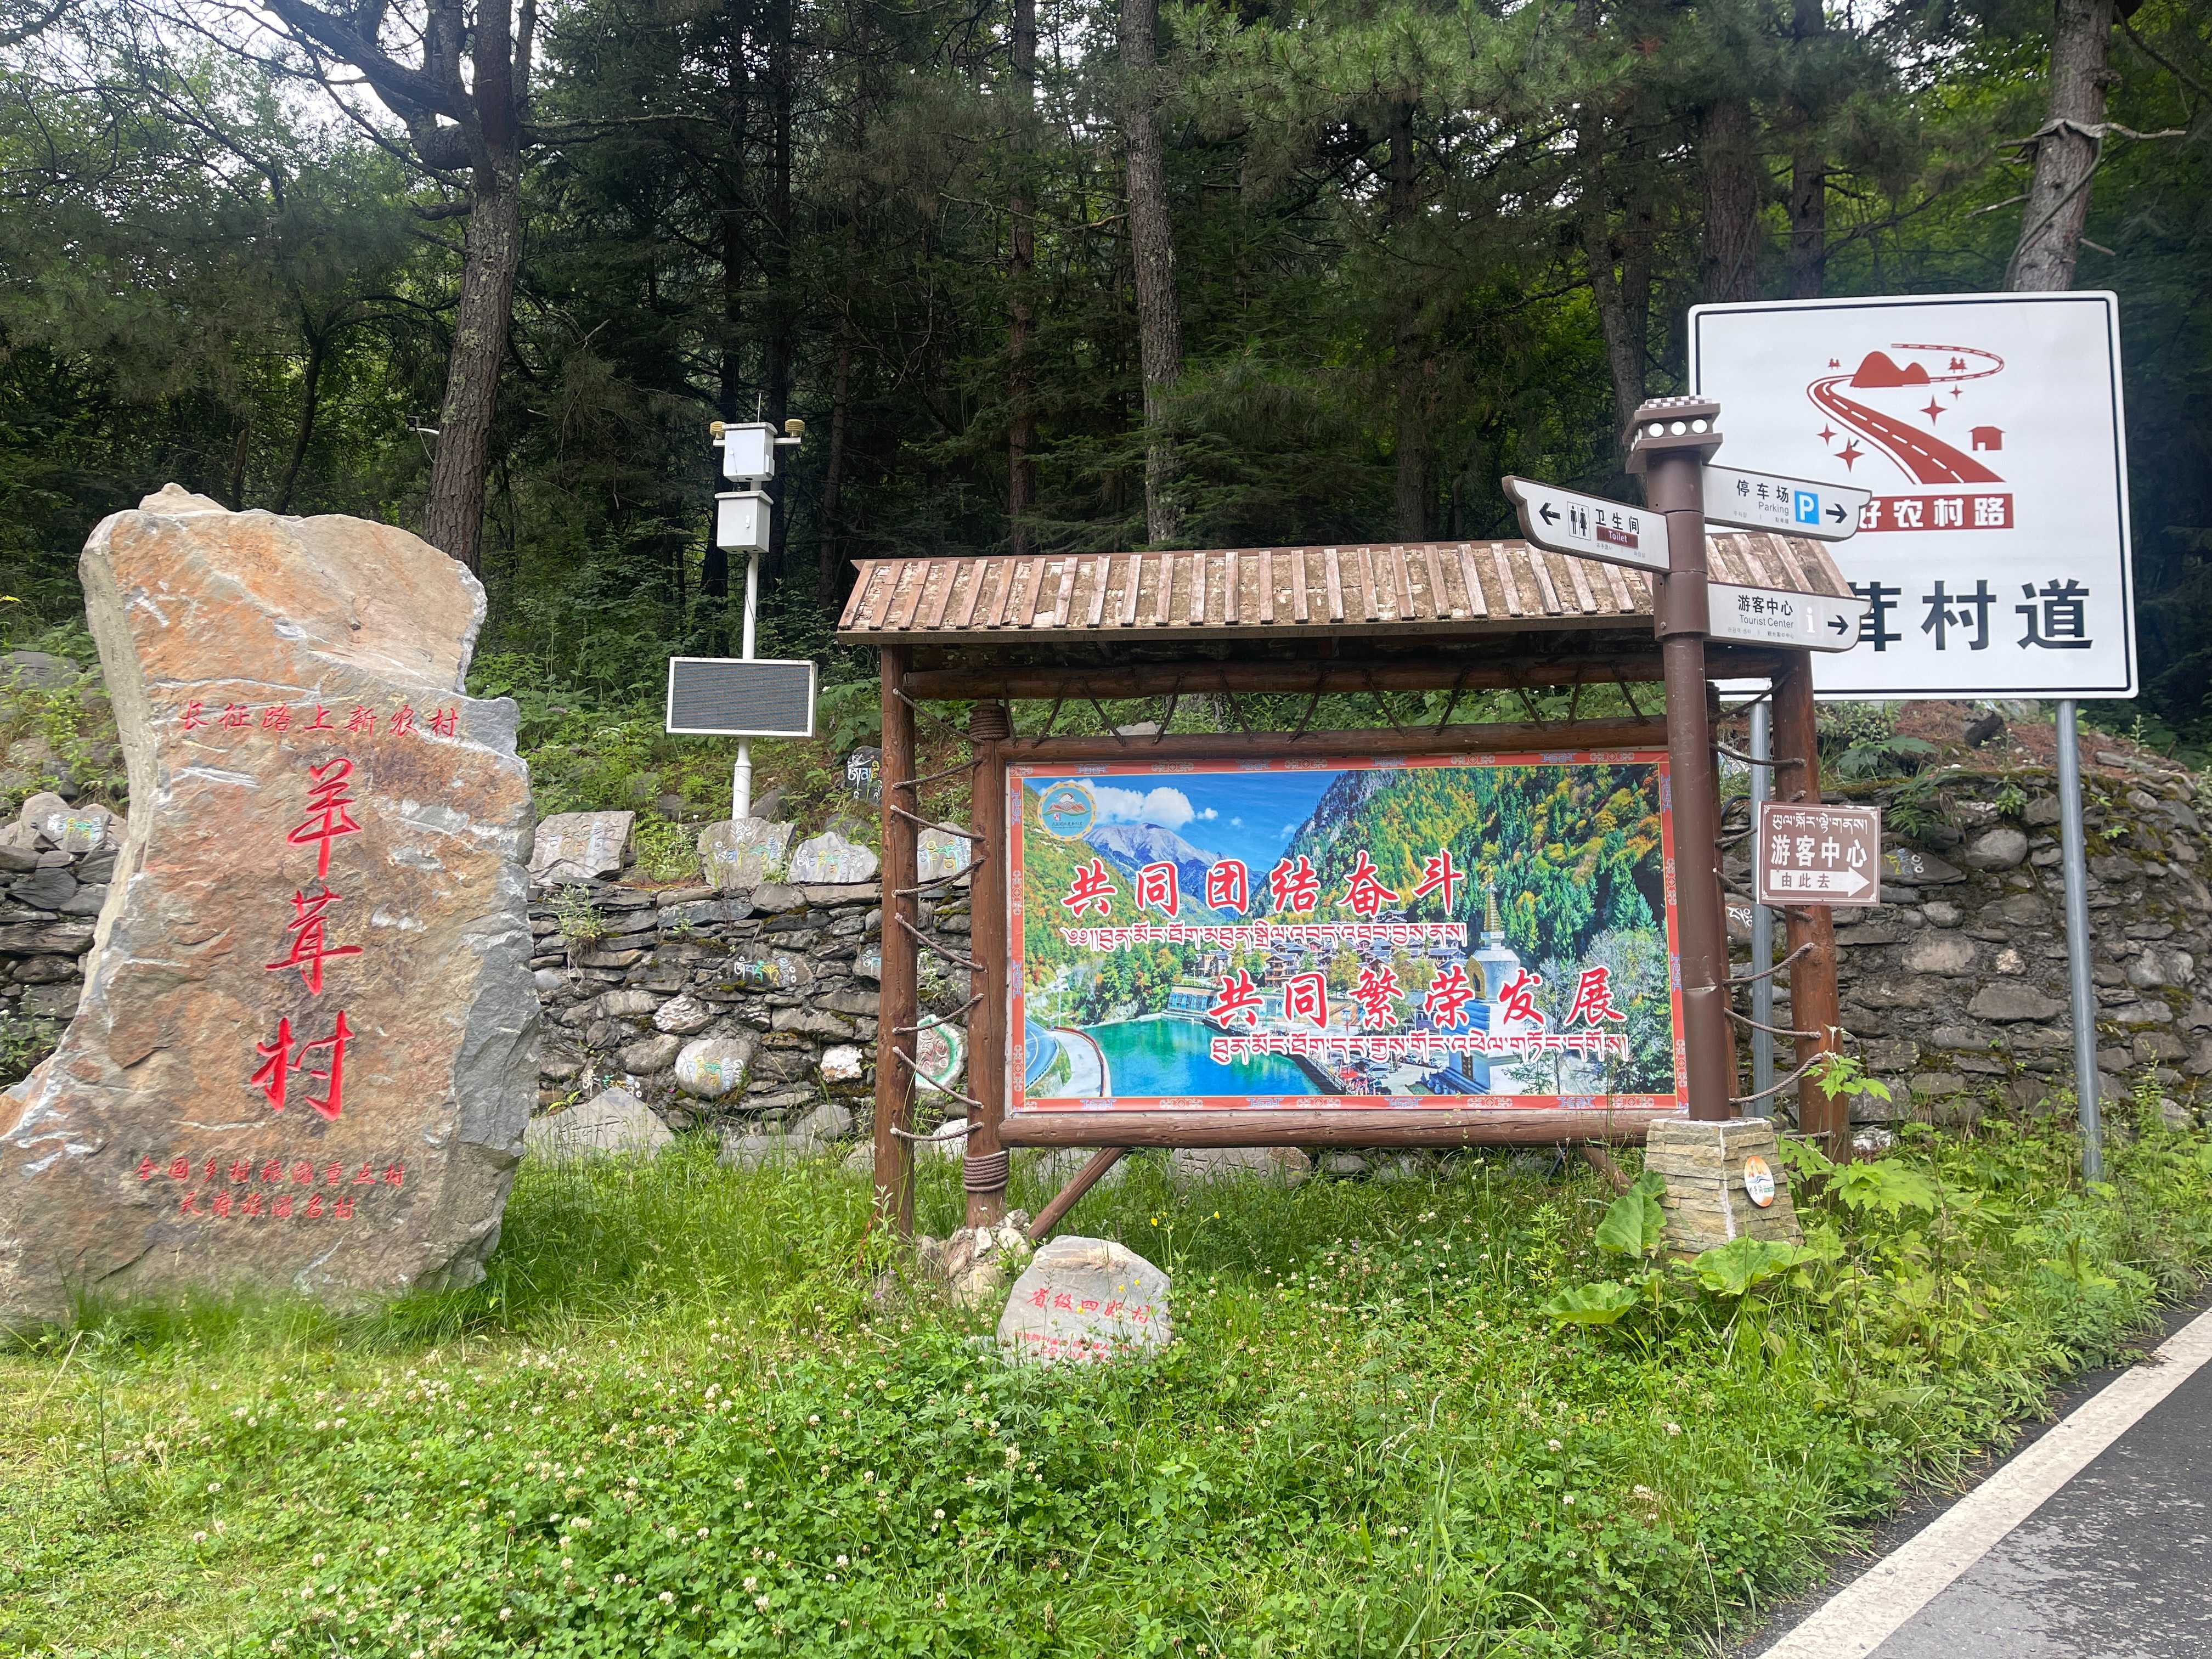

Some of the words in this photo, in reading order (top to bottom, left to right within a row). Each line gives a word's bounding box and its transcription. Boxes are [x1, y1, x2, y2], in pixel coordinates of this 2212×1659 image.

[1736, 479, 1789, 503] 停车场
[1595, 508, 1640, 535] 卫生间
[1758, 501, 1789, 516] Parking
[1608, 530, 1628, 543] Toilet
[1737, 594, 1793, 616] 游客中心
[1739, 614, 1766, 626] Tourist
[1767, 618, 1794, 628] Center
[180, 699, 459, 740] 长征路上新农村
[1771, 834, 1867, 868] 游客中心
[1063, 851, 1463, 916] 共同团结奋斗
[1781, 872, 1831, 889] 由此去
[250, 757, 364, 1122] 羊茸村
[1209, 964, 1625, 1031] 共同繁荣发展
[134, 1155, 405, 1187] 全国乡村旅游重点村
[179, 1189, 356, 1220] 天府旅游名村
